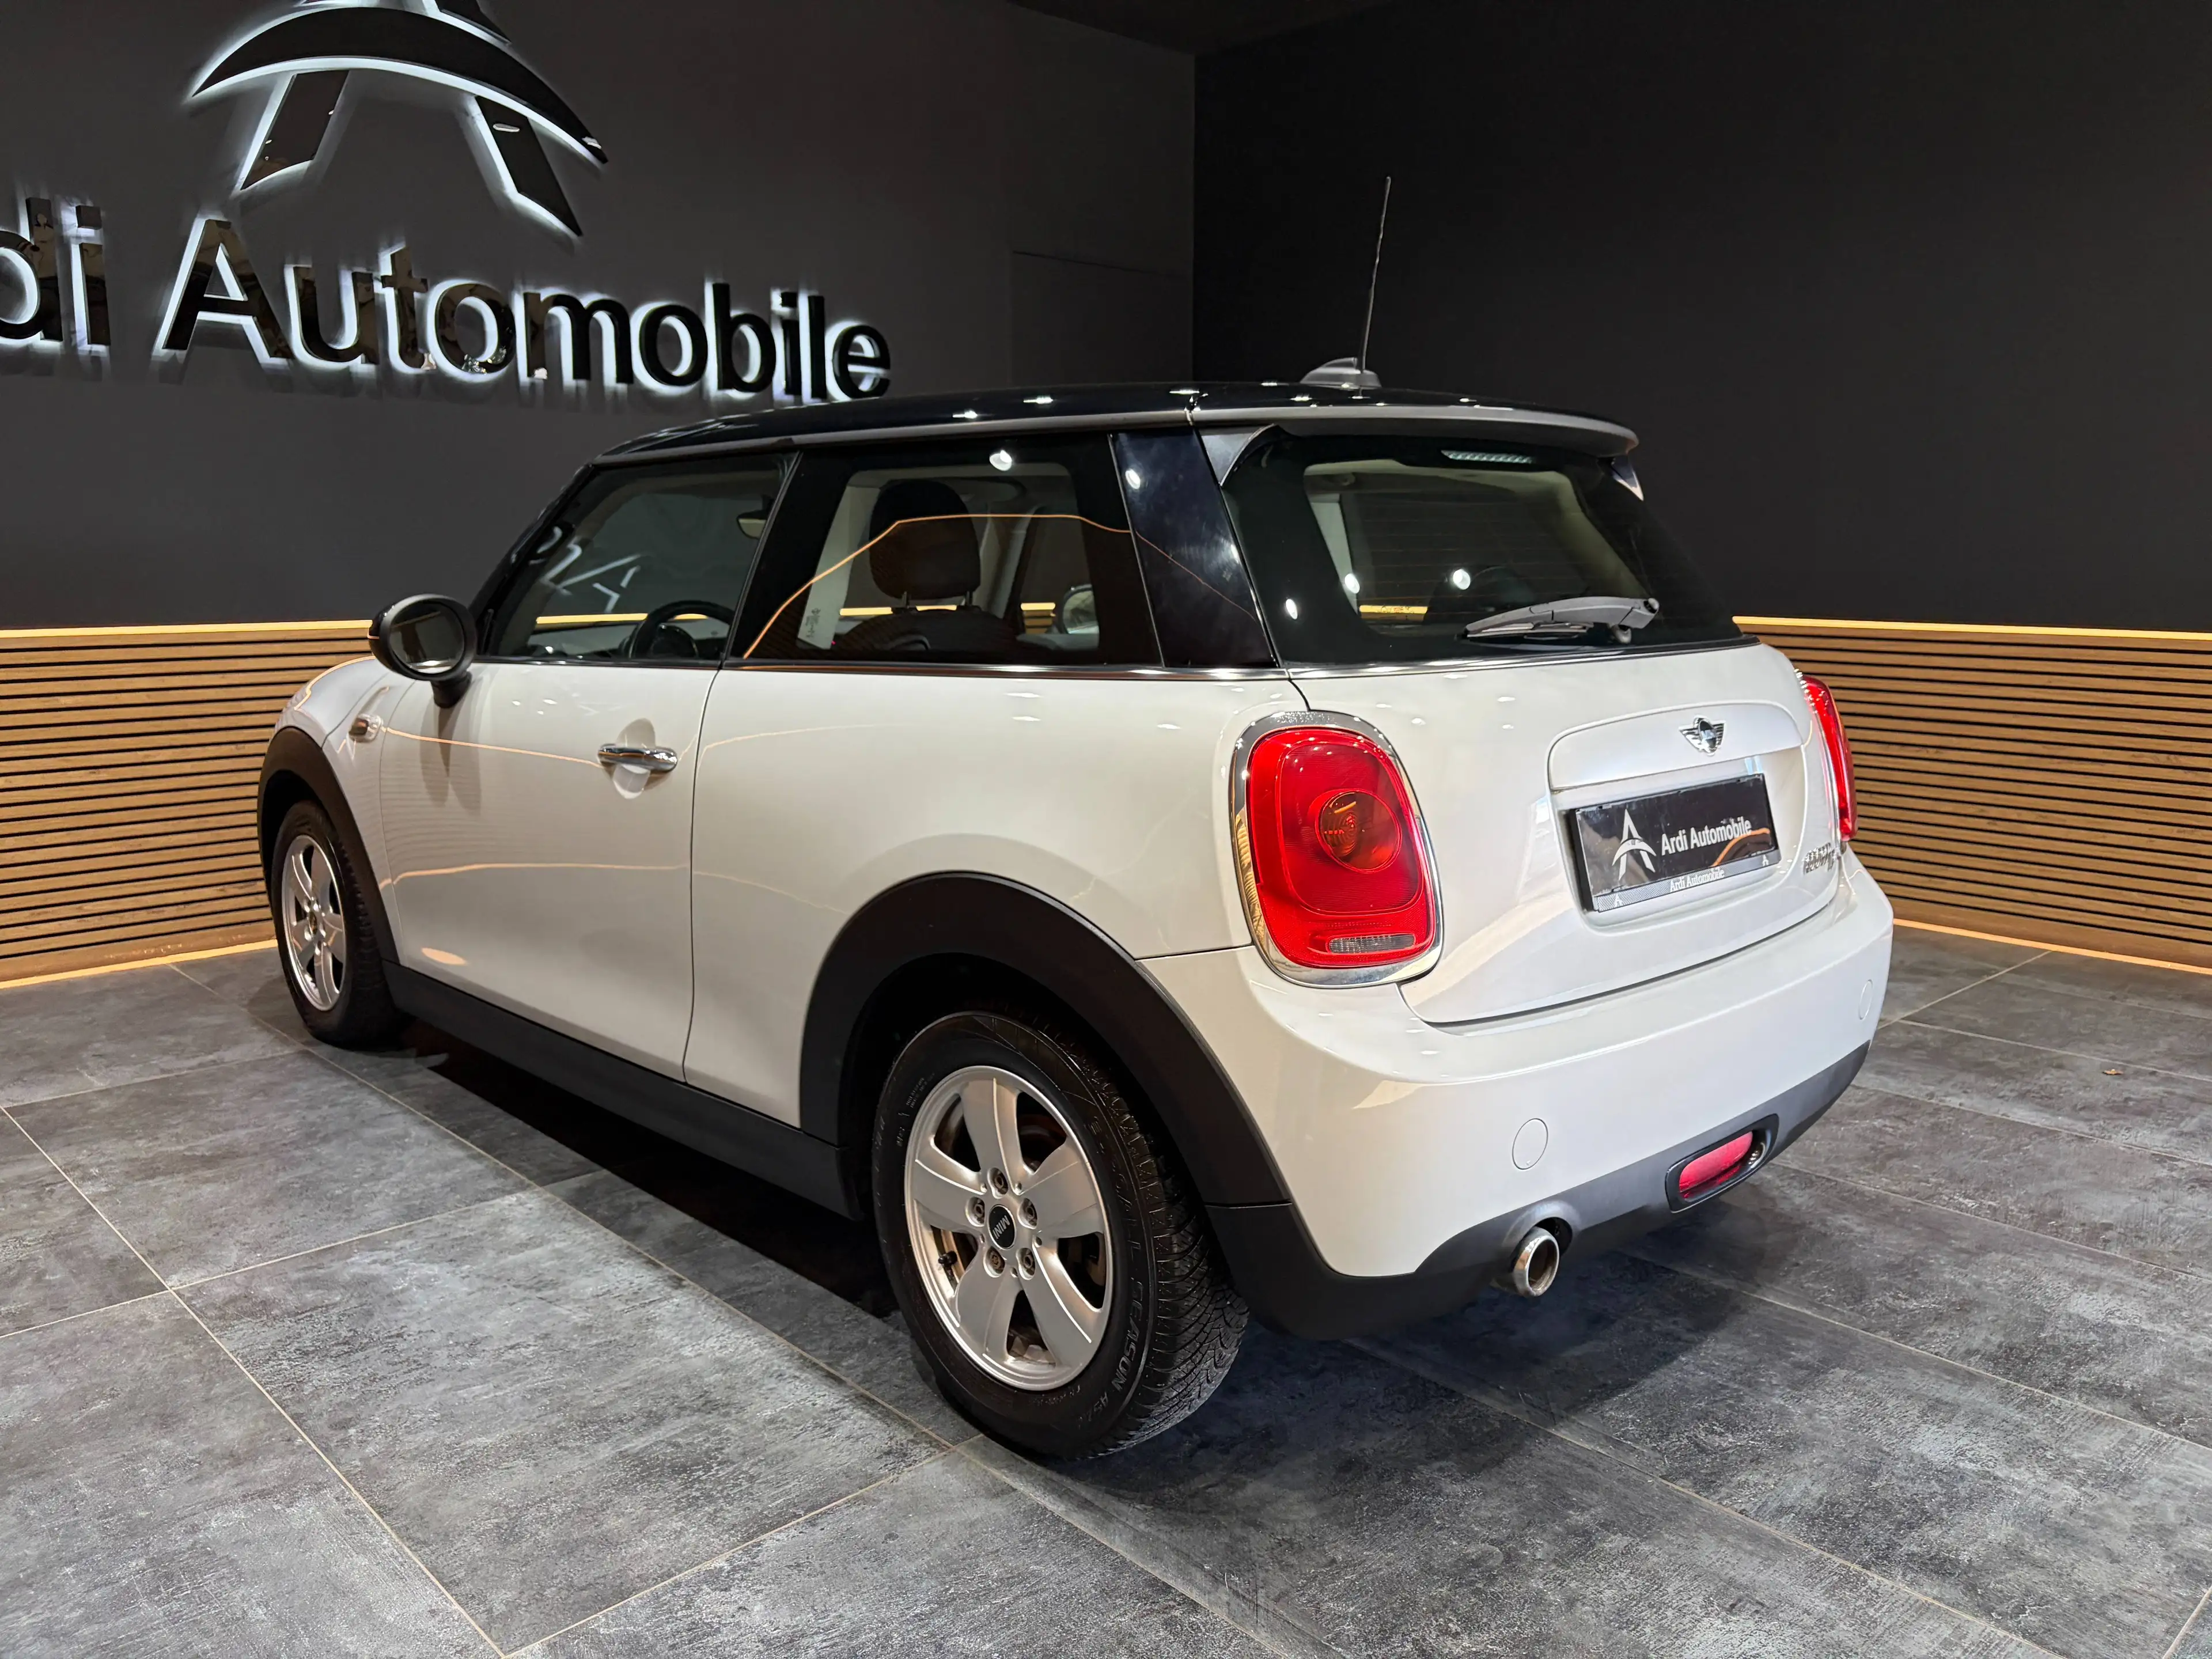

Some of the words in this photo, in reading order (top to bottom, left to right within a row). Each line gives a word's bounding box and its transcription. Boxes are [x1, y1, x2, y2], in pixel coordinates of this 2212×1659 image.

[163, 219, 892, 400] Automobile
[1662, 829, 1688, 856] Ardi
[1691, 816, 1752, 849] Automobile
[1671, 876, 1685, 892] Ardi
[1687, 866, 1725, 888] Automobile
[993, 1215, 1010, 1240] MINI
